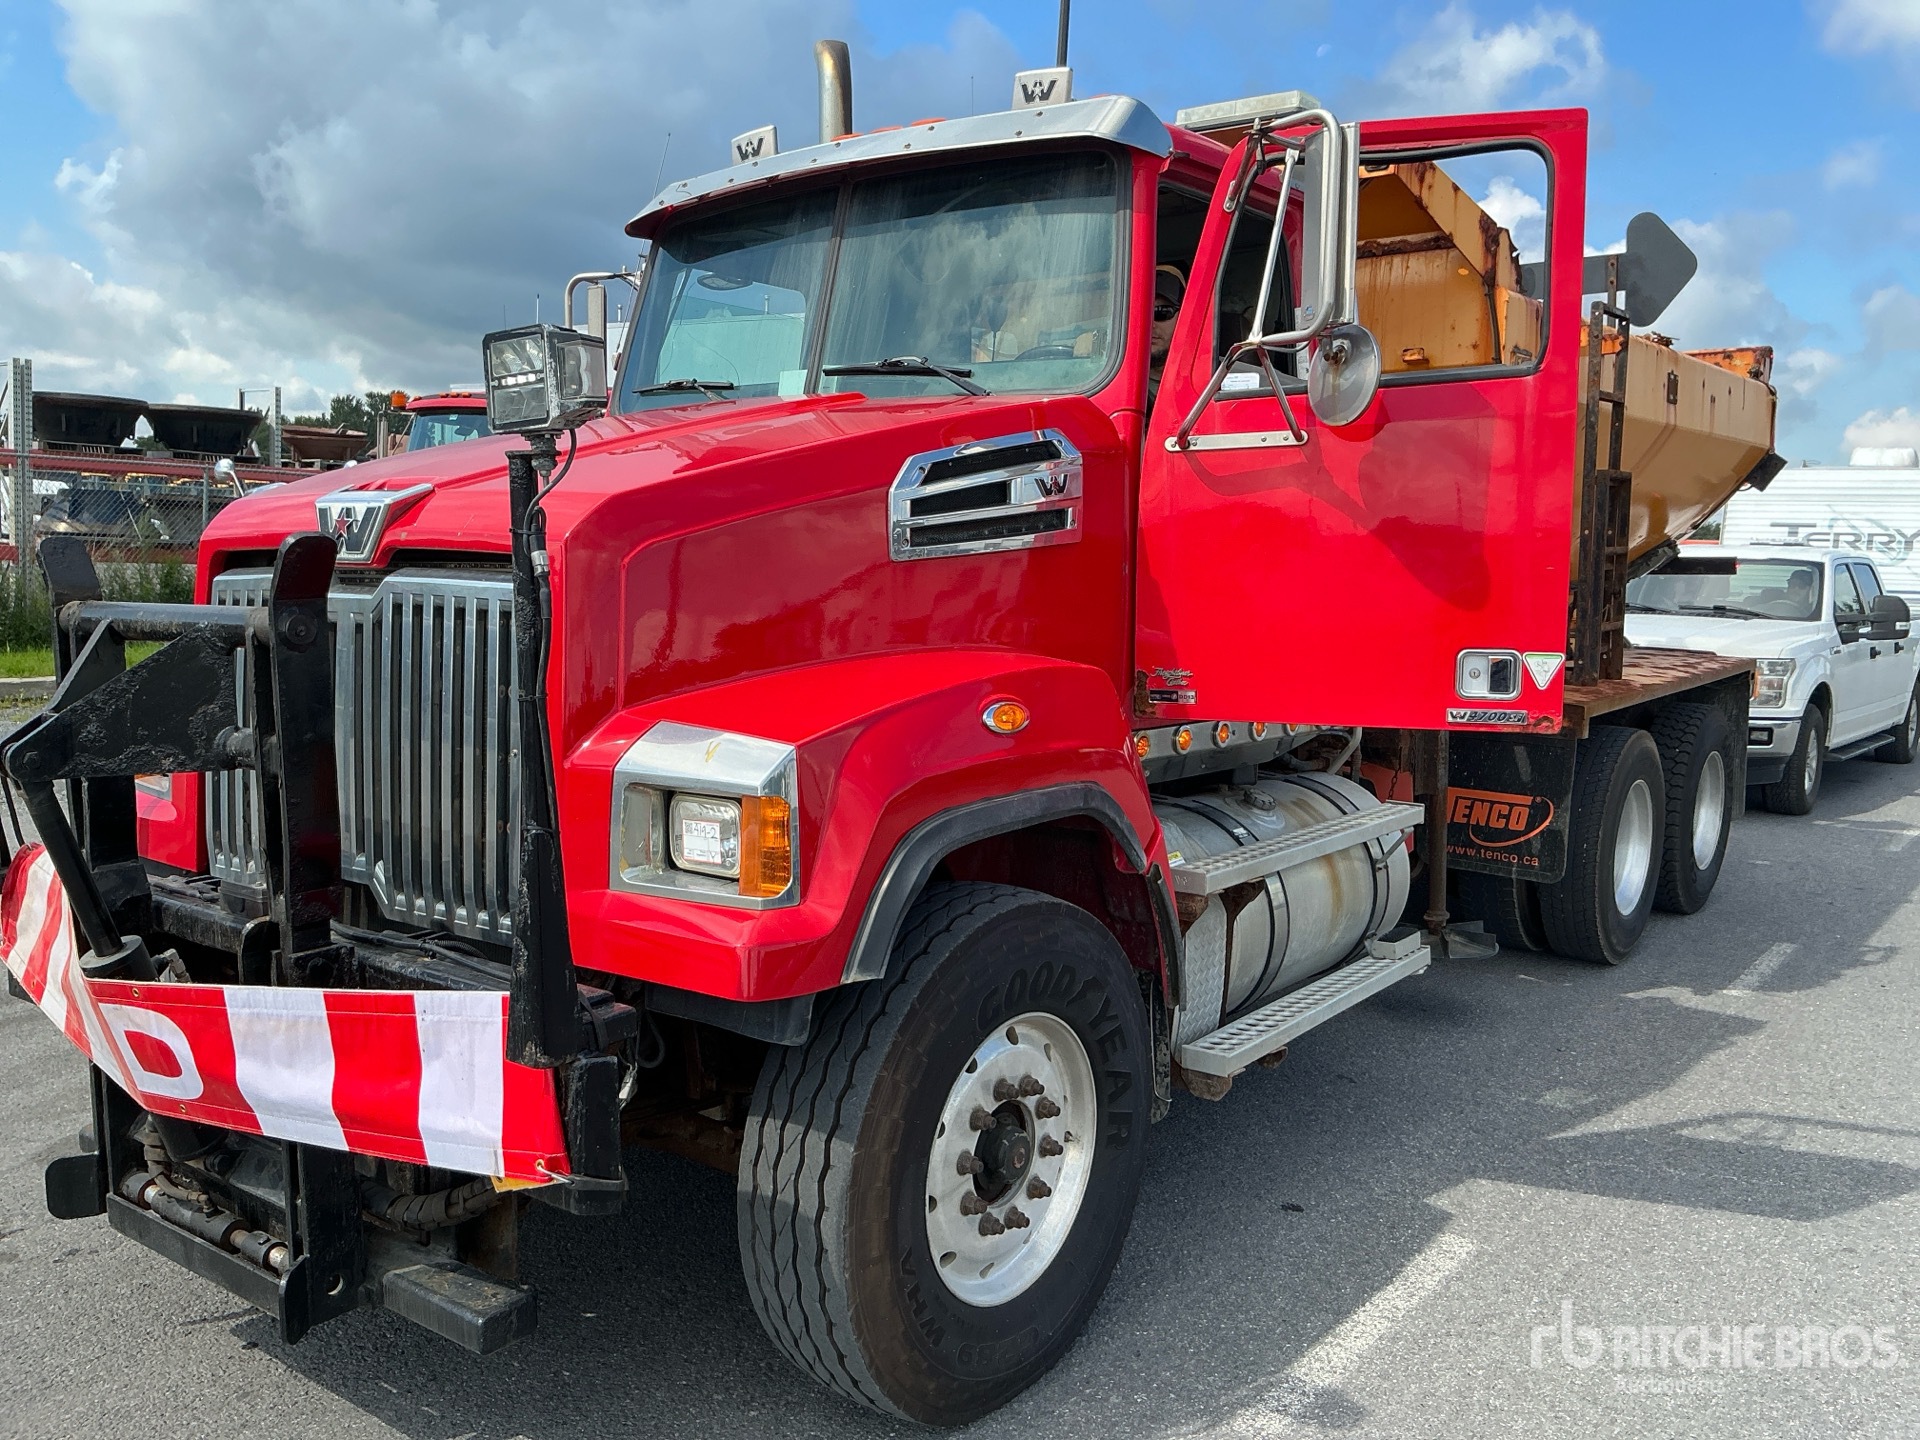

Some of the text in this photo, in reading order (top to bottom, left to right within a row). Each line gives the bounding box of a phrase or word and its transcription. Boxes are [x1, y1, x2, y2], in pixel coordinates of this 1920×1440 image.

[1770, 522, 1920, 551] TERRY
[98, 1002, 204, 1100] D
[976, 960, 1133, 1150] GOODYEAR
